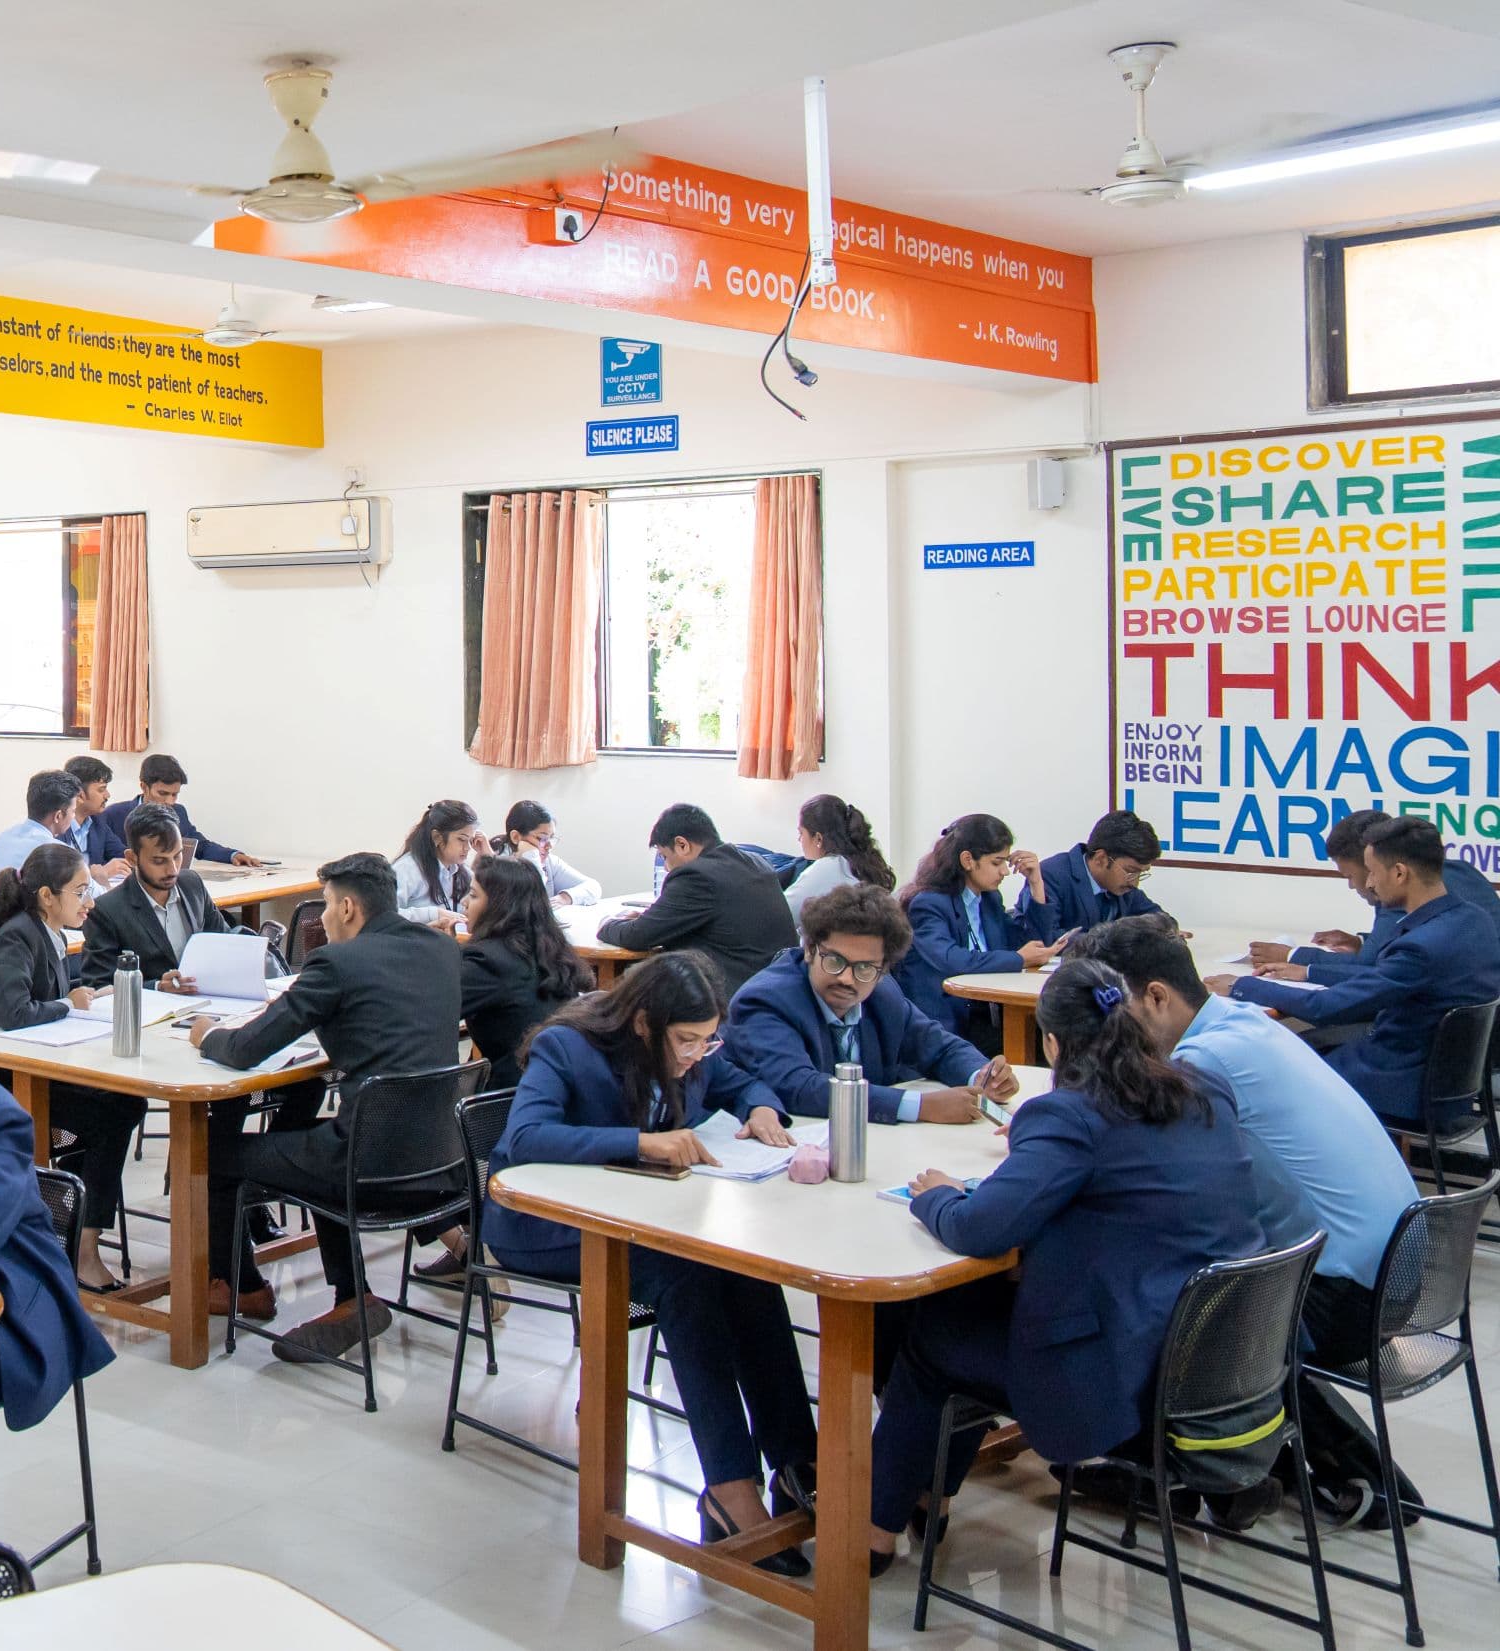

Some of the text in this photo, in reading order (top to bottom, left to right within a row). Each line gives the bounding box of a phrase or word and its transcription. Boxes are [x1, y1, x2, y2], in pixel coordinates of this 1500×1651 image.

[601, 160, 1064, 290] Something very agical happens when you
[603, 241, 885, 321] READ A GOOD BOOK.
[46, 322, 61, 342] of
[156, 343, 175, 359] are
[181, 343, 202, 363] the
[207, 351, 241, 369] most
[80, 362, 102, 383] the
[108, 370, 143, 389] most
[147, 373, 192, 394] patient
[197, 379, 210, 397] of
[214, 380, 269, 405] teachers.
[617, 382, 646, 393] CCTV
[635, 373, 658, 381] UNDER
[144, 402, 195, 422] Charles
[607, 393, 656, 403] SURVEILLANCE
[592, 424, 673, 447] SILENCE PLEASE
[1169, 434, 1446, 480] DISCOVER
[1121, 455, 1162, 562] LIVE
[1171, 471, 1446, 527] SHARE
[927, 547, 1031, 564] READING AREA
[1172, 520, 1446, 560] RESEARCH
[1123, 558, 1446, 602] PARTICIPATE
[1123, 603, 1446, 637] BROWSE LOUNGE
[1124, 641, 1500, 722] THINK
[1124, 723, 1203, 742] ENJOY
[1124, 743, 1203, 763] INFORM
[1124, 763, 1203, 785] BEGIN
